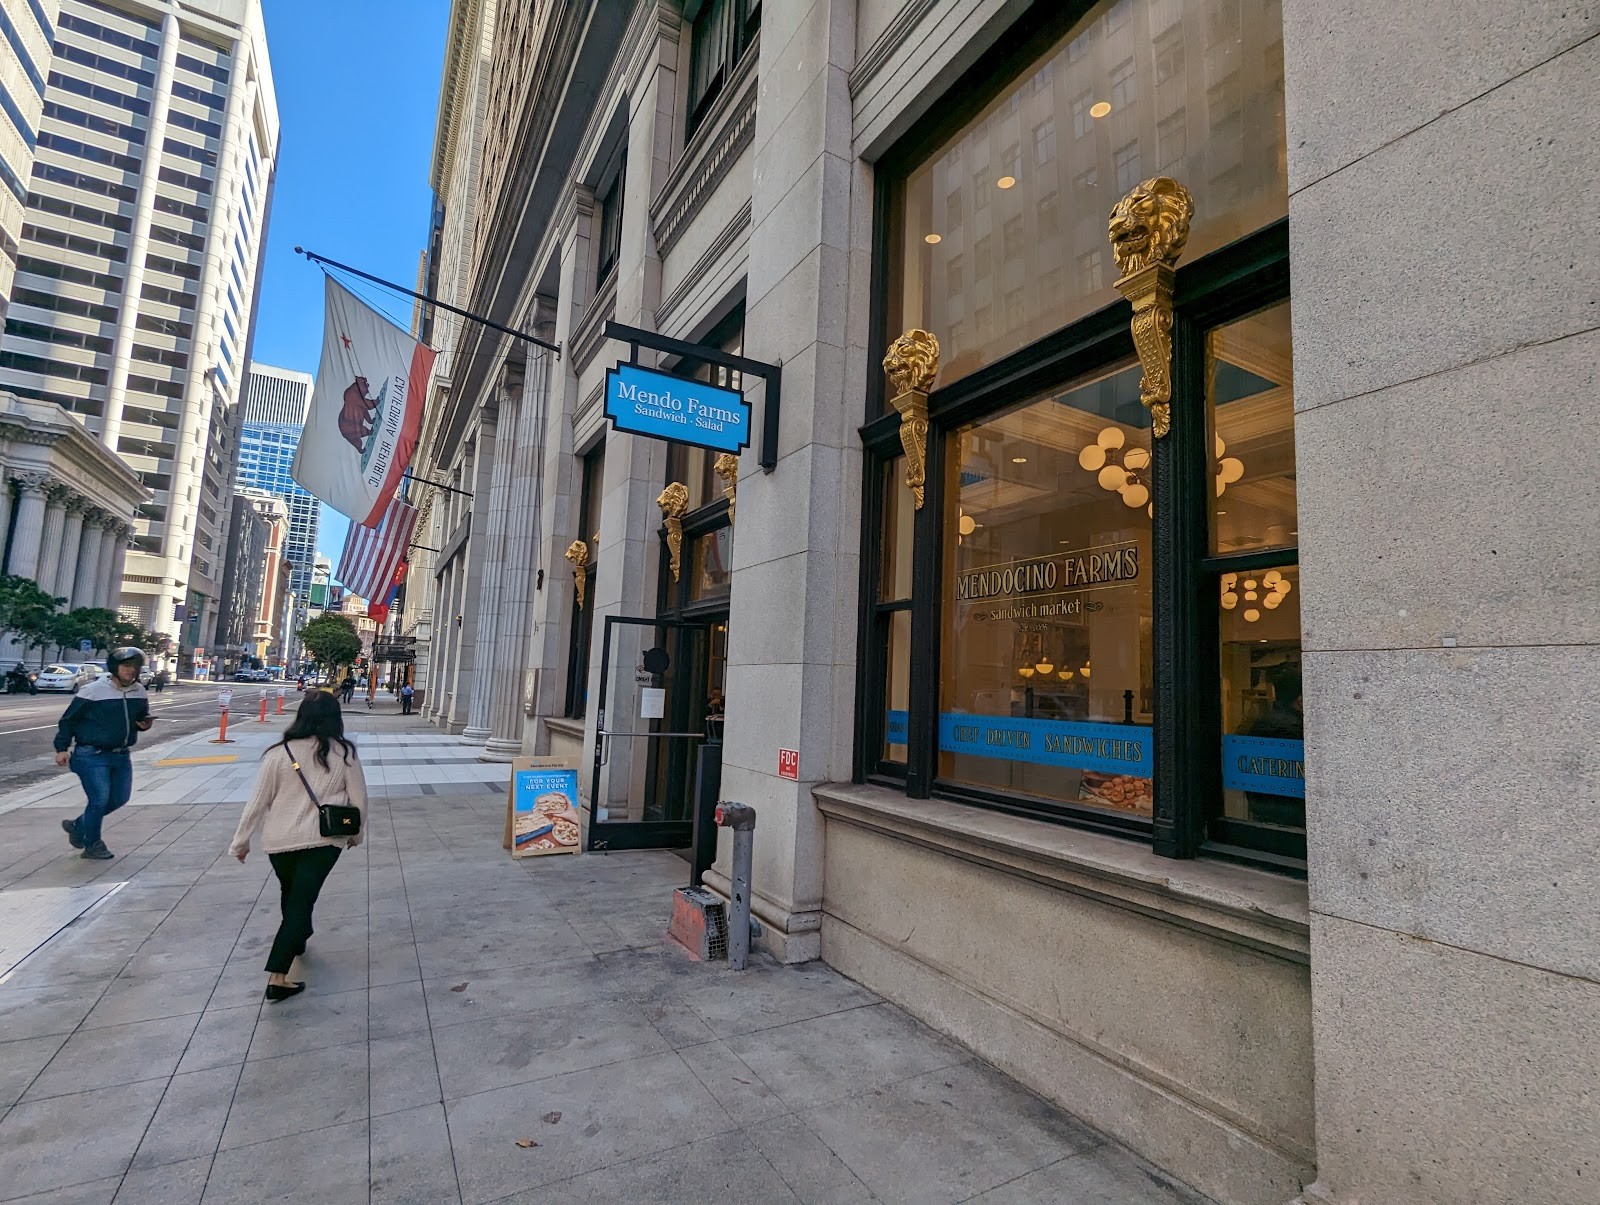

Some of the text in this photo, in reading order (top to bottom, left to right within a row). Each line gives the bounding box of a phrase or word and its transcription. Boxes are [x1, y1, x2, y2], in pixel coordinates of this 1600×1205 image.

[617, 381, 740, 425] Mendo Farms
[634, 404, 723, 432] Sandwich Salad
[956, 547, 1138, 600] MENDOCINO FARMS
[990, 598, 1081, 621] sandwich market
[781, 751, 796, 766] FDC
[987, 728, 1031, 749] DRIVEN
[1045, 733, 1143, 763] SANDWICHES
